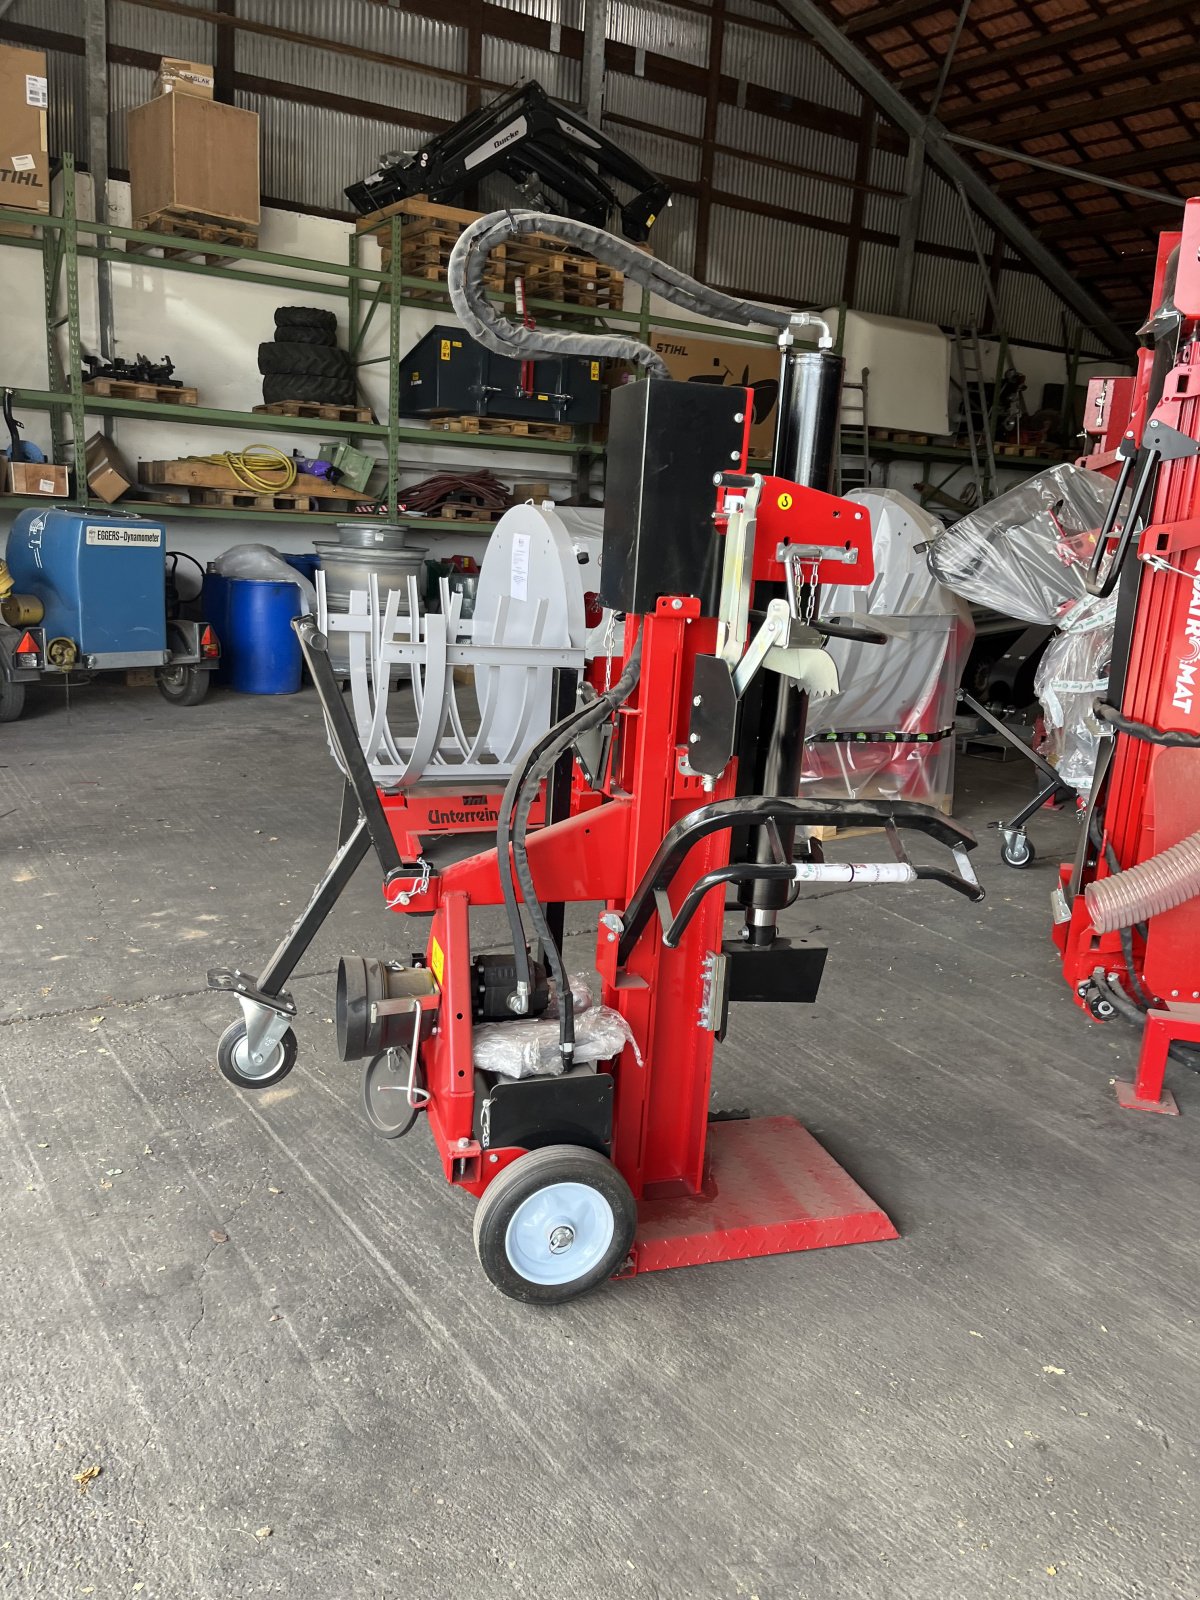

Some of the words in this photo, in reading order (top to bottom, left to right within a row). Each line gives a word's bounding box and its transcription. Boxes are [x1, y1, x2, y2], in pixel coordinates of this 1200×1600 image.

[493, 129, 520, 149] Quicke
[0, 168, 44, 188] TIHL
[655, 342, 689, 356] STIHL
[428, 807, 500, 825] Unterrein
